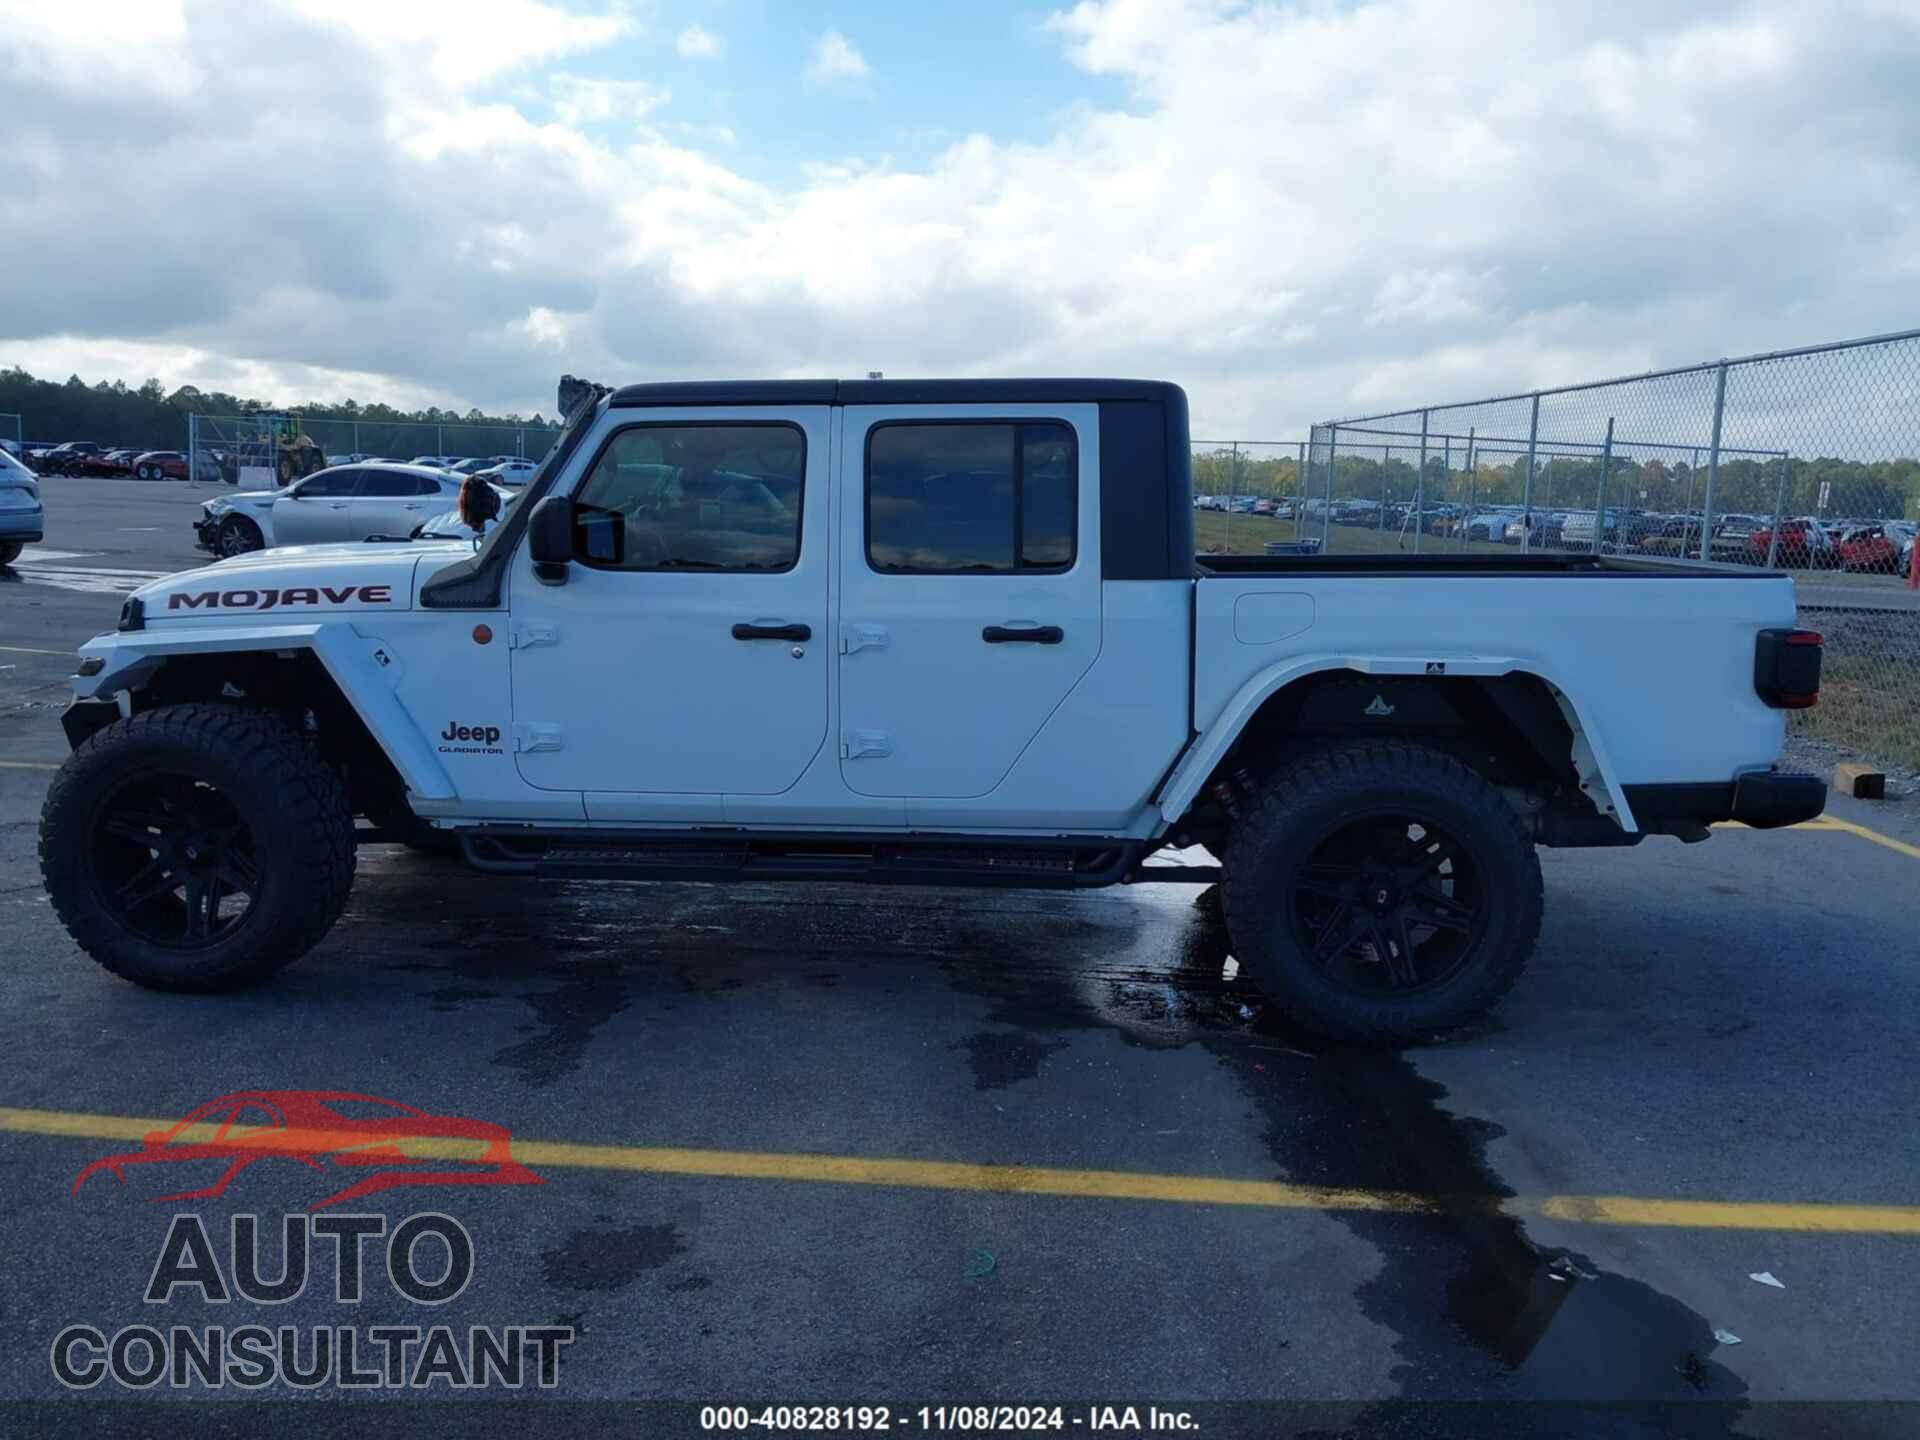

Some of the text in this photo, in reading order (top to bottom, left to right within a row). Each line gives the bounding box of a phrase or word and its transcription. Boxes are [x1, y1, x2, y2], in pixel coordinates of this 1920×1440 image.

[168, 585, 392, 610] MOJAVE
[441, 721, 501, 746] Jeep
[438, 745, 504, 755] GLADIATOR
